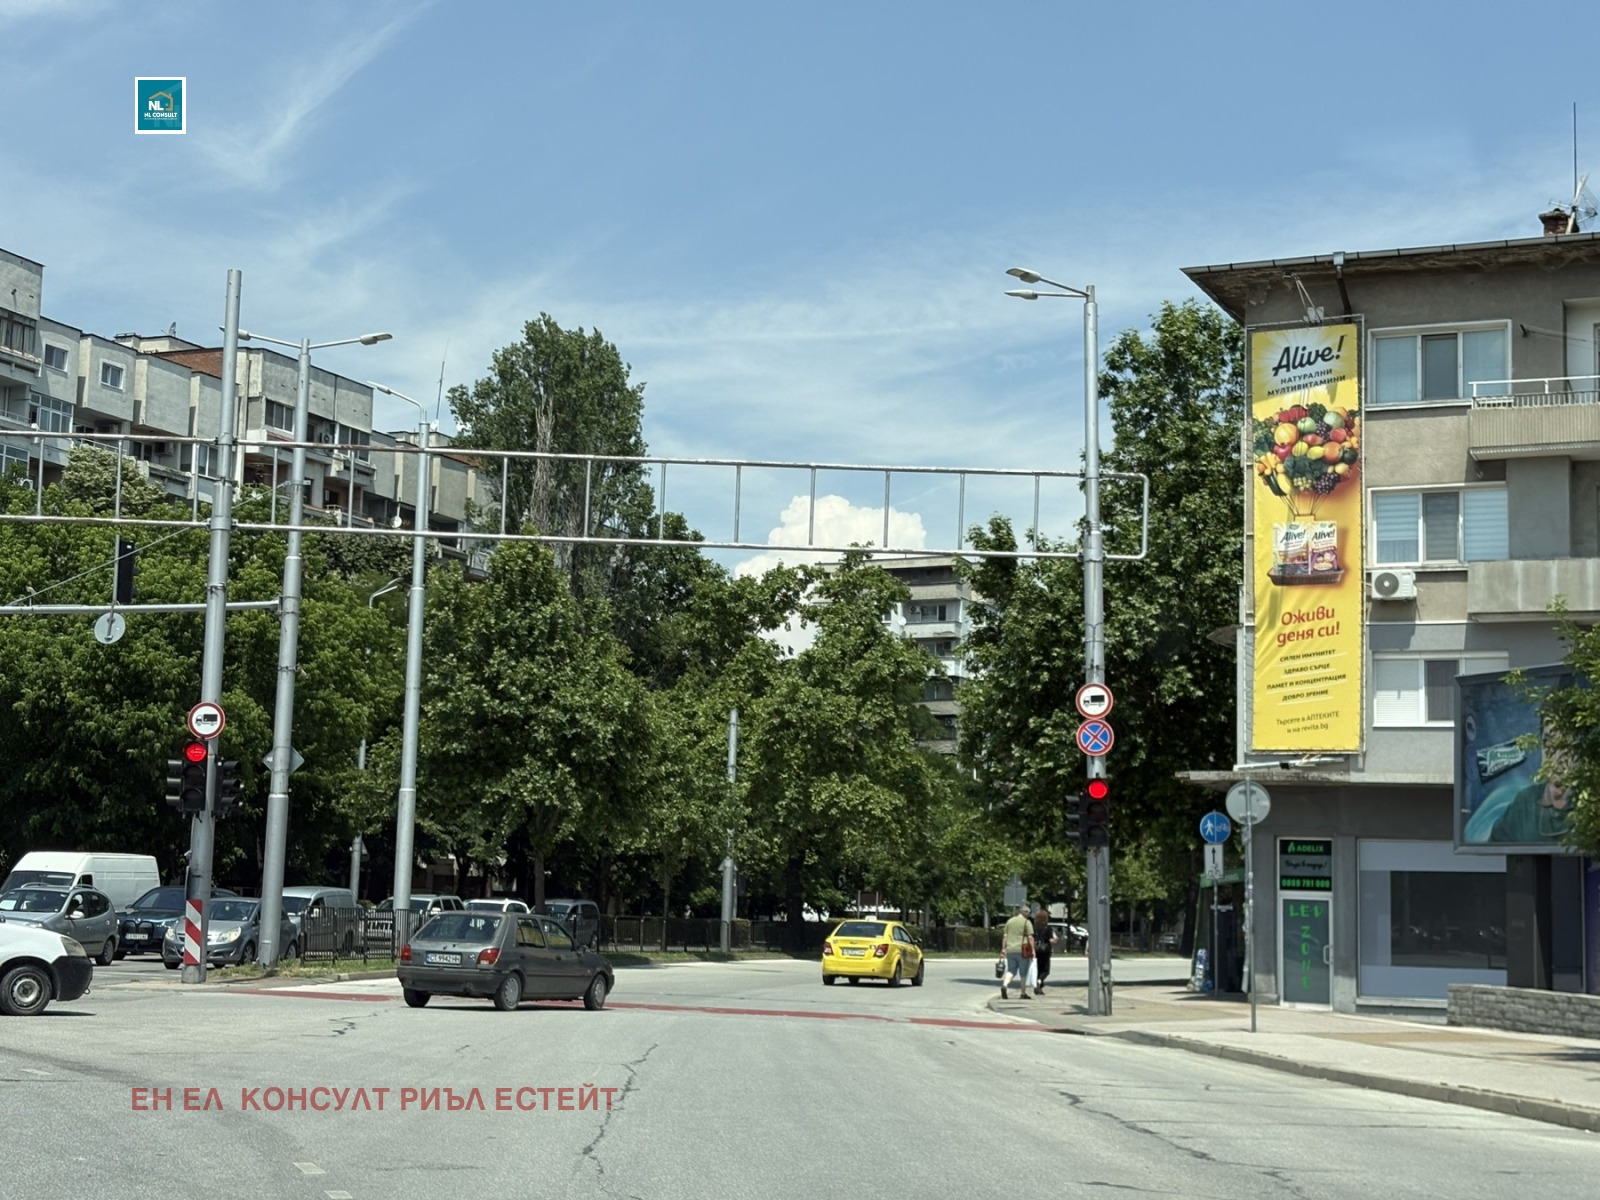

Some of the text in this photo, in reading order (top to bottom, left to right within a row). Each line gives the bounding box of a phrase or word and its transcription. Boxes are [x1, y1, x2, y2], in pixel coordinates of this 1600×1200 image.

[1272, 335, 1347, 377] Alive!
[1280, 368, 1333, 385] НАТУРАЛНИ
[1267, 375, 1346, 397] МУЛТИВИТАМИНИ
[1281, 605, 1335, 626] Оживи
[1277, 621, 1340, 648] деня си!
[1279, 649, 1336, 663] СИЛЕН ИМУНИТЕТ
[1284, 663, 1331, 675] ЗДРАВО СЪРЦЕ
[1266, 682, 1288, 690] ПАМЕТ
[1295, 674, 1347, 686] КОНЦЕНТРАЦИЯ
[1282, 689, 1329, 702] ДОБРО ЗРЕНИЕ
[1306, 711, 1340, 722] АПТЕКИТЕ
[1301, 723, 1329, 732] revita.bg
[1296, 844, 1324, 853] ADELIX
